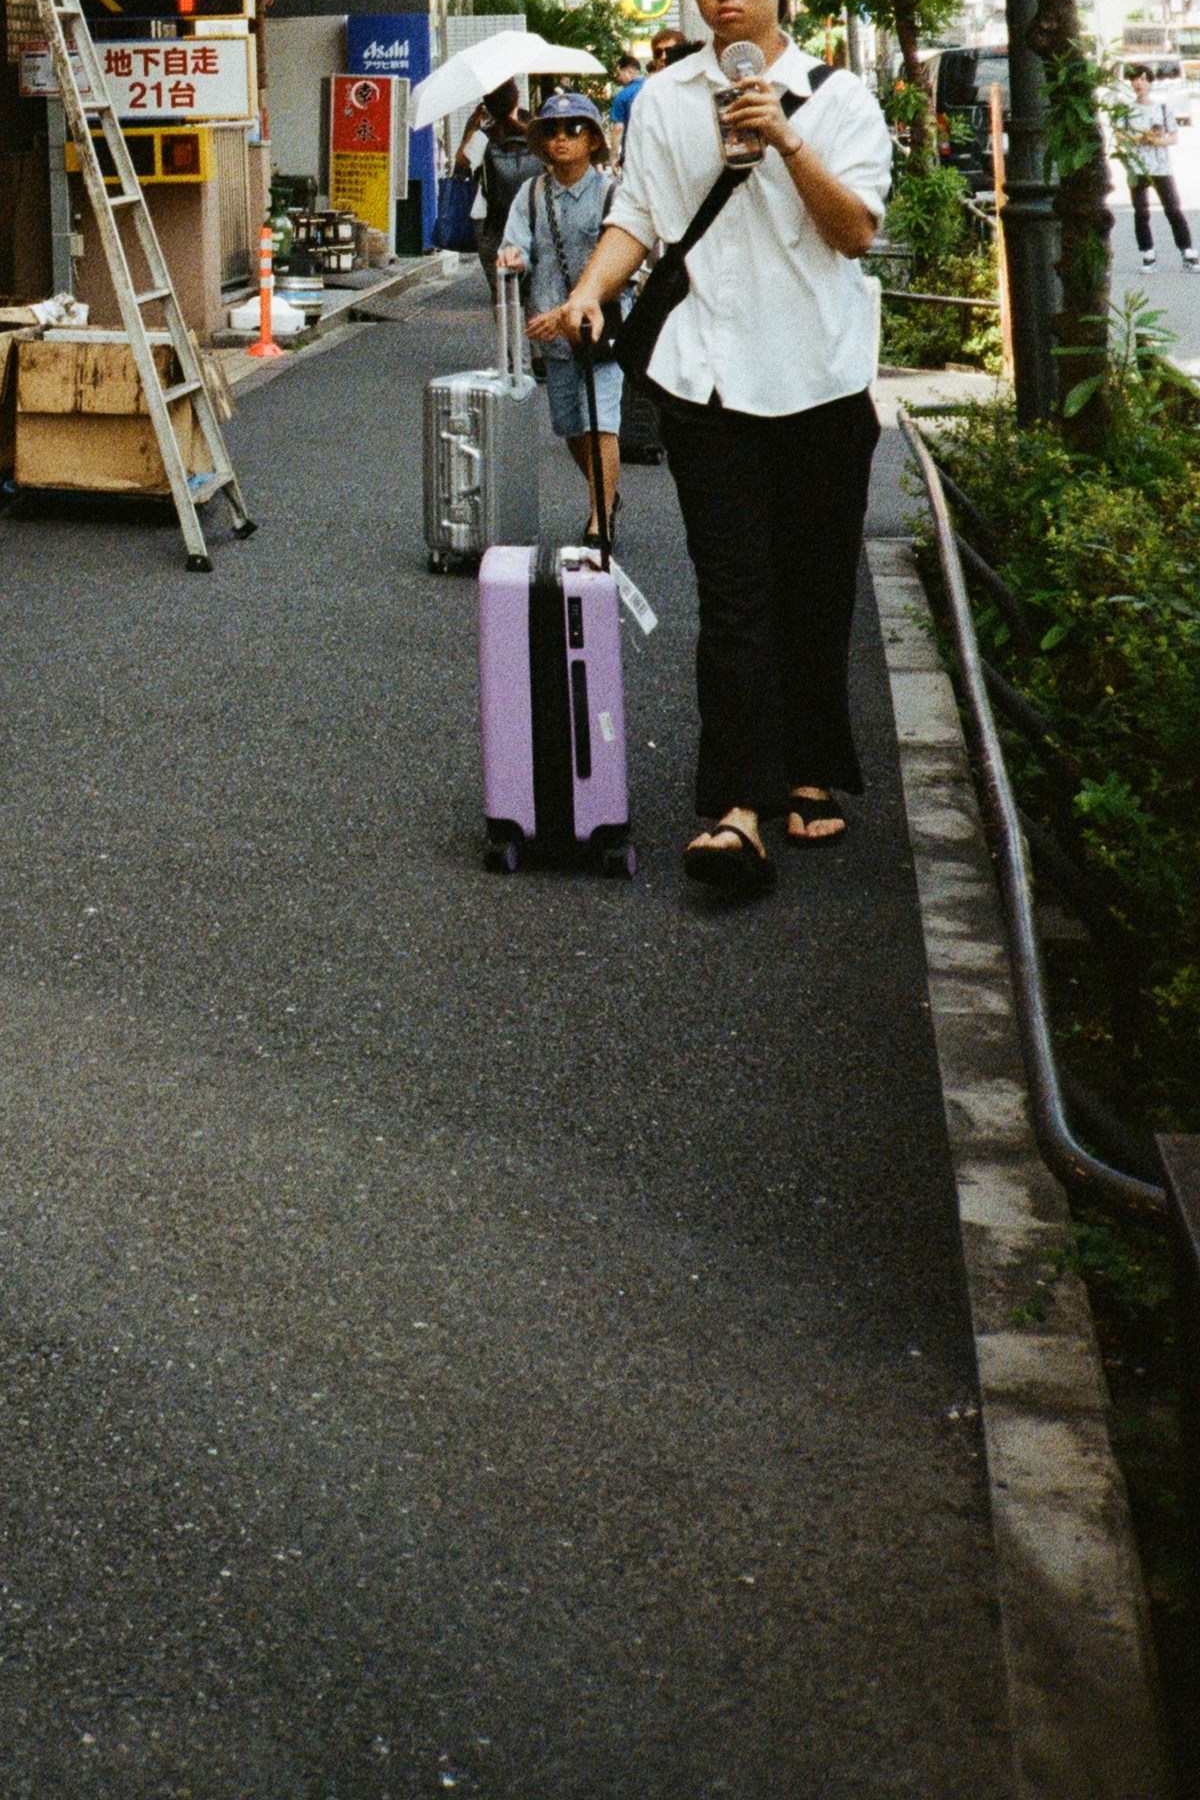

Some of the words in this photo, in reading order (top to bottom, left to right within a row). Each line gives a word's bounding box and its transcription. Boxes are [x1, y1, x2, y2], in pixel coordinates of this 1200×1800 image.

[104, 46, 220, 77] 地下自走
[362, 39, 410, 59] Asahi
[128, 80, 196, 109] 21台
